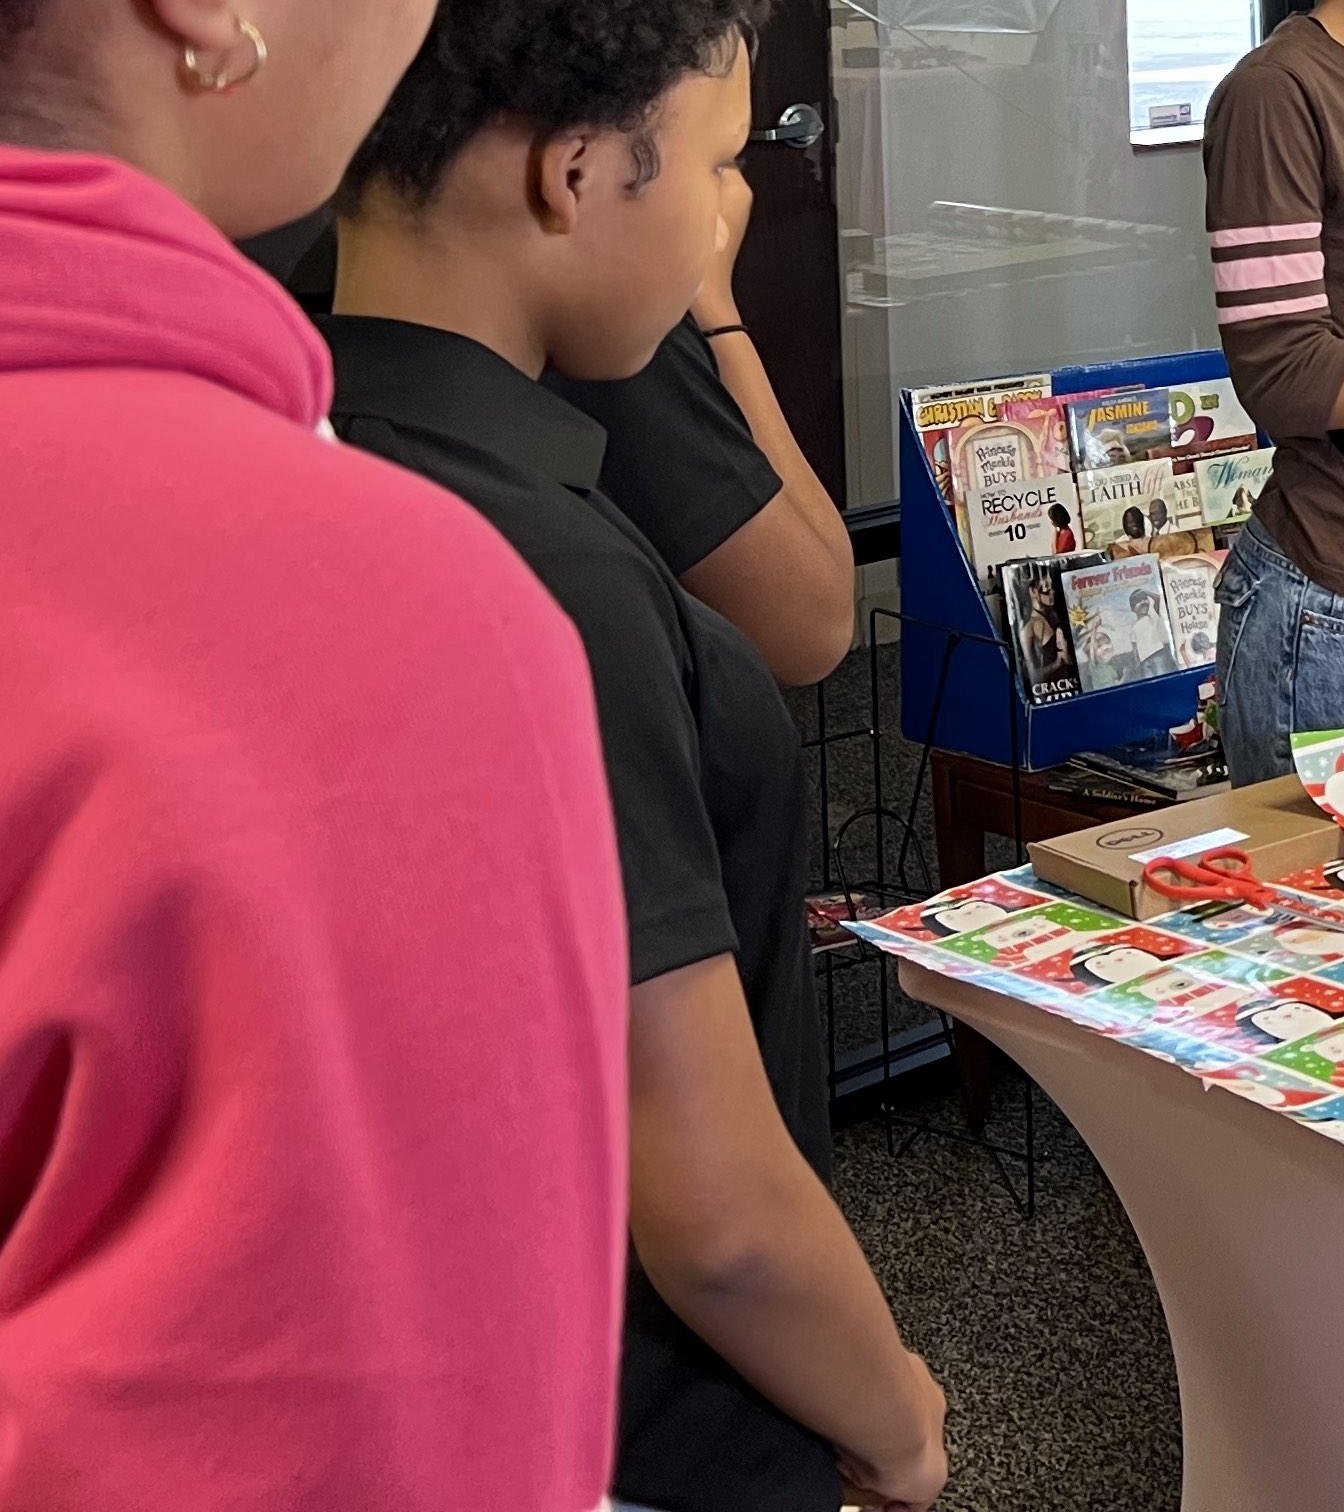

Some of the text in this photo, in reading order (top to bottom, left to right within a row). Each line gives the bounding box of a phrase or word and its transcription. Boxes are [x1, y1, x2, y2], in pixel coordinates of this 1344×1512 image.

[916, 397, 985, 427] CHRISTIAN
[1087, 401, 1150, 432] JASMINE
[976, 445, 1017, 463] Princess
[984, 471, 1017, 488] BUYS
[1110, 473, 1132, 484] NEED
[1133, 472, 1140, 480] A
[1090, 480, 1142, 503] FAITH
[981, 487, 1057, 516] RECYCLE
[985, 505, 1042, 526] Husbands
[1004, 523, 1026, 542] 10
[1112, 562, 1152, 581] Friends
[1178, 603, 1208, 619] BUYS
[1180, 621, 1208, 634] House
[1091, 789, 1128, 801] Soldier's
[1130, 793, 1156, 805] Home
